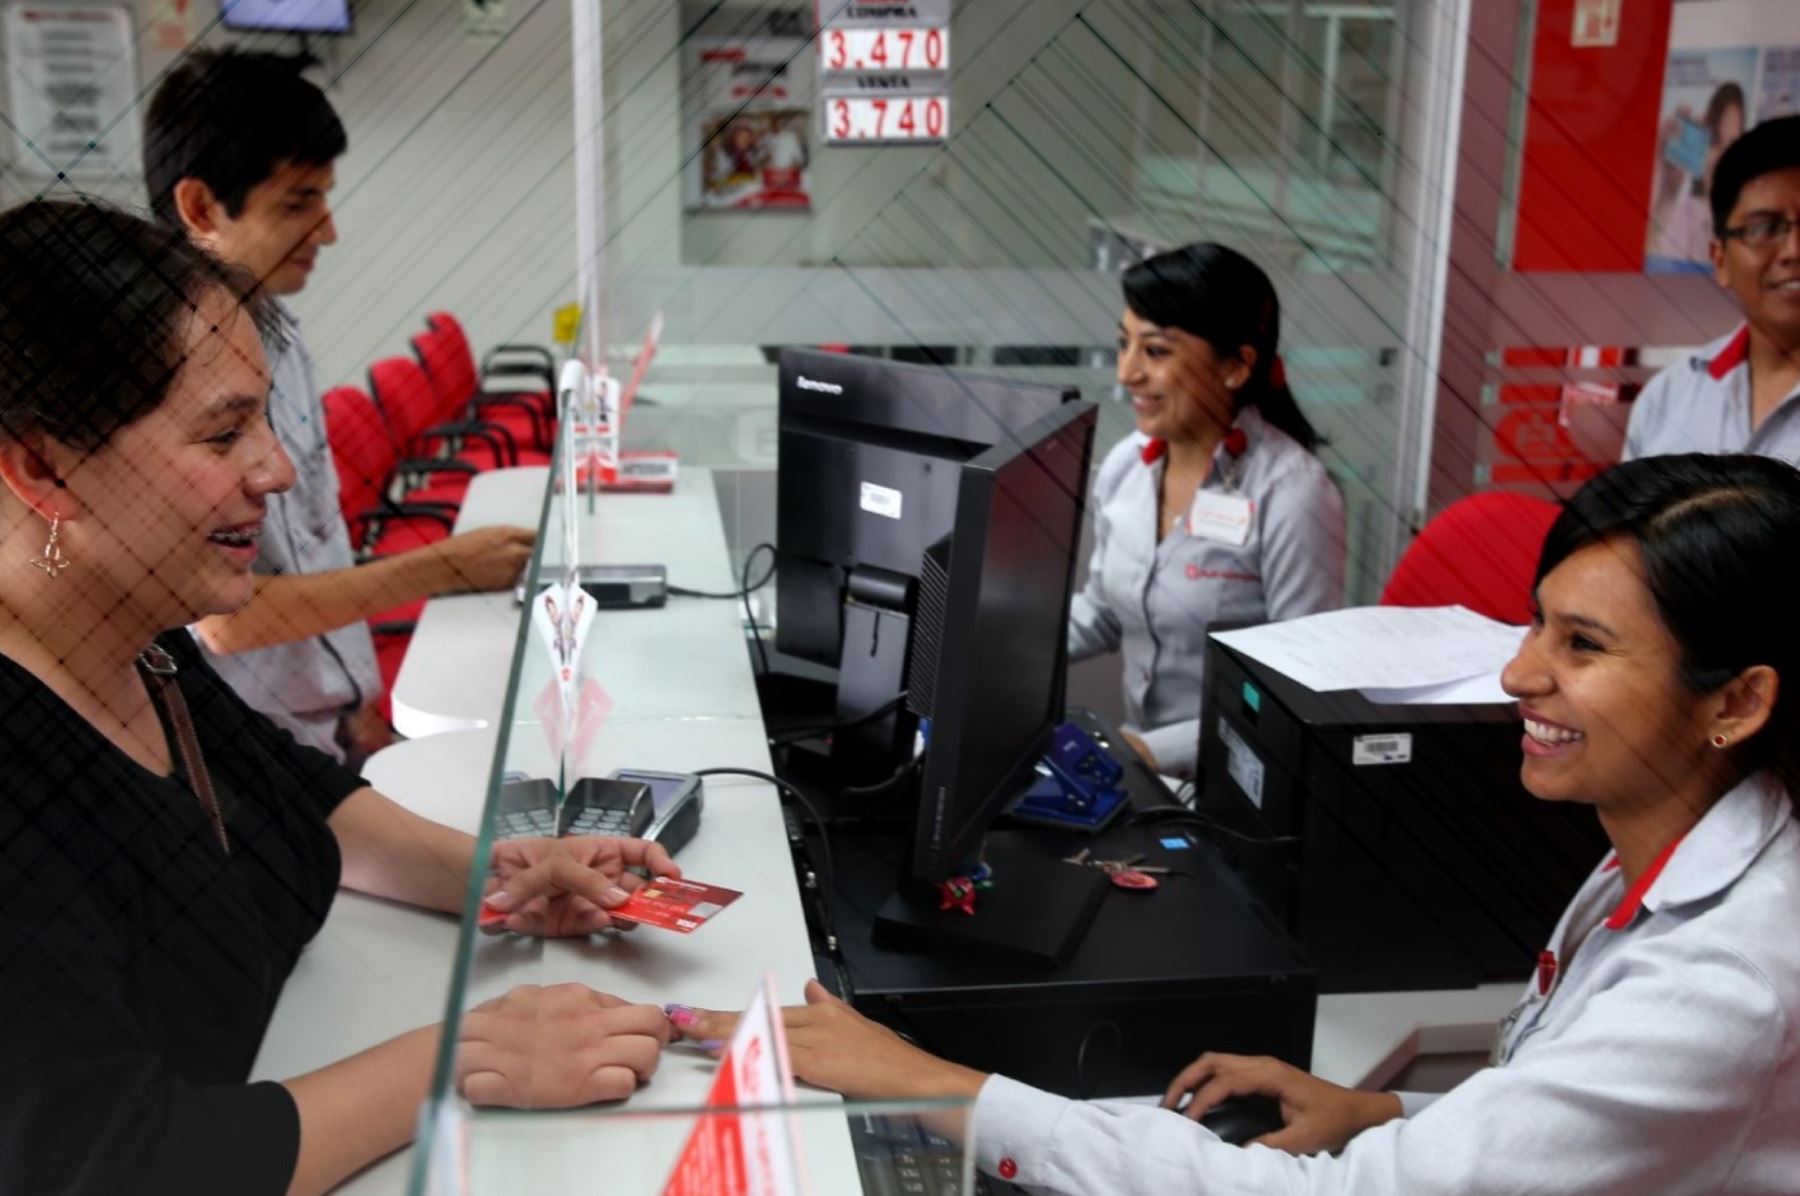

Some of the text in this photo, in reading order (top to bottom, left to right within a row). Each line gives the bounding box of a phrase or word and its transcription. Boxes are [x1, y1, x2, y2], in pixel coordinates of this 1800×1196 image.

[846, 6, 917, 18] COMPRA
[829, 28, 943, 70] 3.470
[857, 75, 910, 88] VENTA
[834, 99, 943, 139] 3.740
